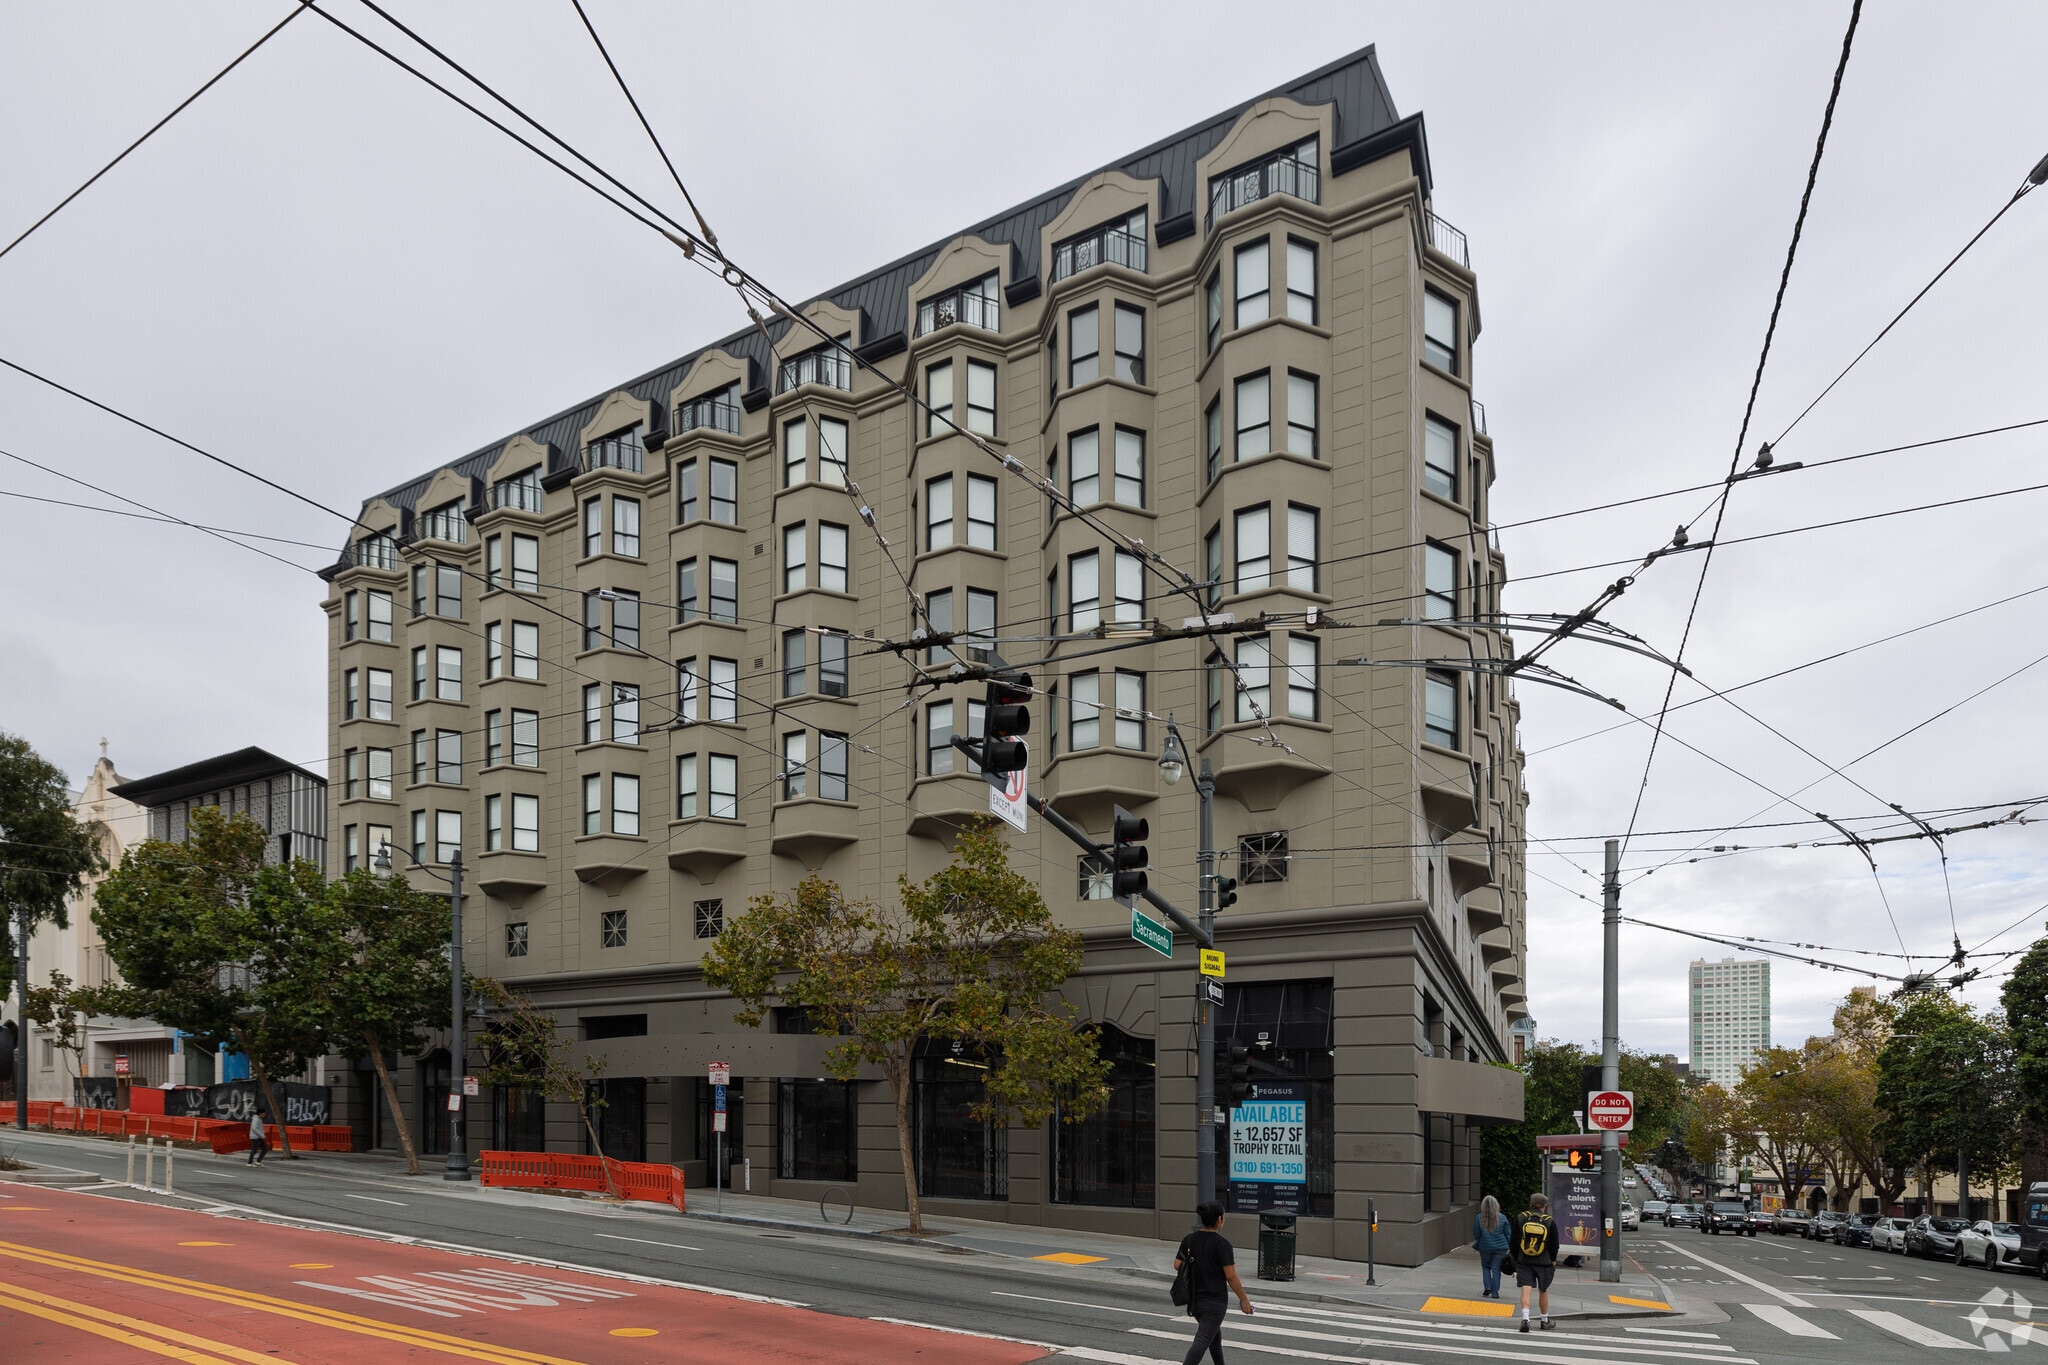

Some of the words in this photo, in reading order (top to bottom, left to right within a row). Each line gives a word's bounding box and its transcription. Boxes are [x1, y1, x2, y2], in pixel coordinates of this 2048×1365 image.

[992, 793, 1011, 814] EXCEPT
[1012, 806, 1025, 823] MUNI
[1135, 918, 1169, 950] Sacramento
[1206, 954, 1219, 962] MUNI
[1204, 962, 1221, 972] SIGNAL
[115, 1063, 129, 1072] FDC
[1233, 1106, 1303, 1123] AVAILABLE
[1598, 1115, 1623, 1123] ENTER
[1245, 1126, 1285, 1143] 12,657
[1288, 1127, 1303, 1142] SF
[1233, 1142, 1269, 1155] TROPHY
[1271, 1143, 1303, 1156] RETAIL
[1233, 1161, 1257, 1173] (310)
[1260, 1161, 1303, 1175] 691-1350
[1572, 1177, 1591, 1185] Win
[1573, 1185, 1590, 1194] the
[1567, 1194, 1596, 1203] talent
